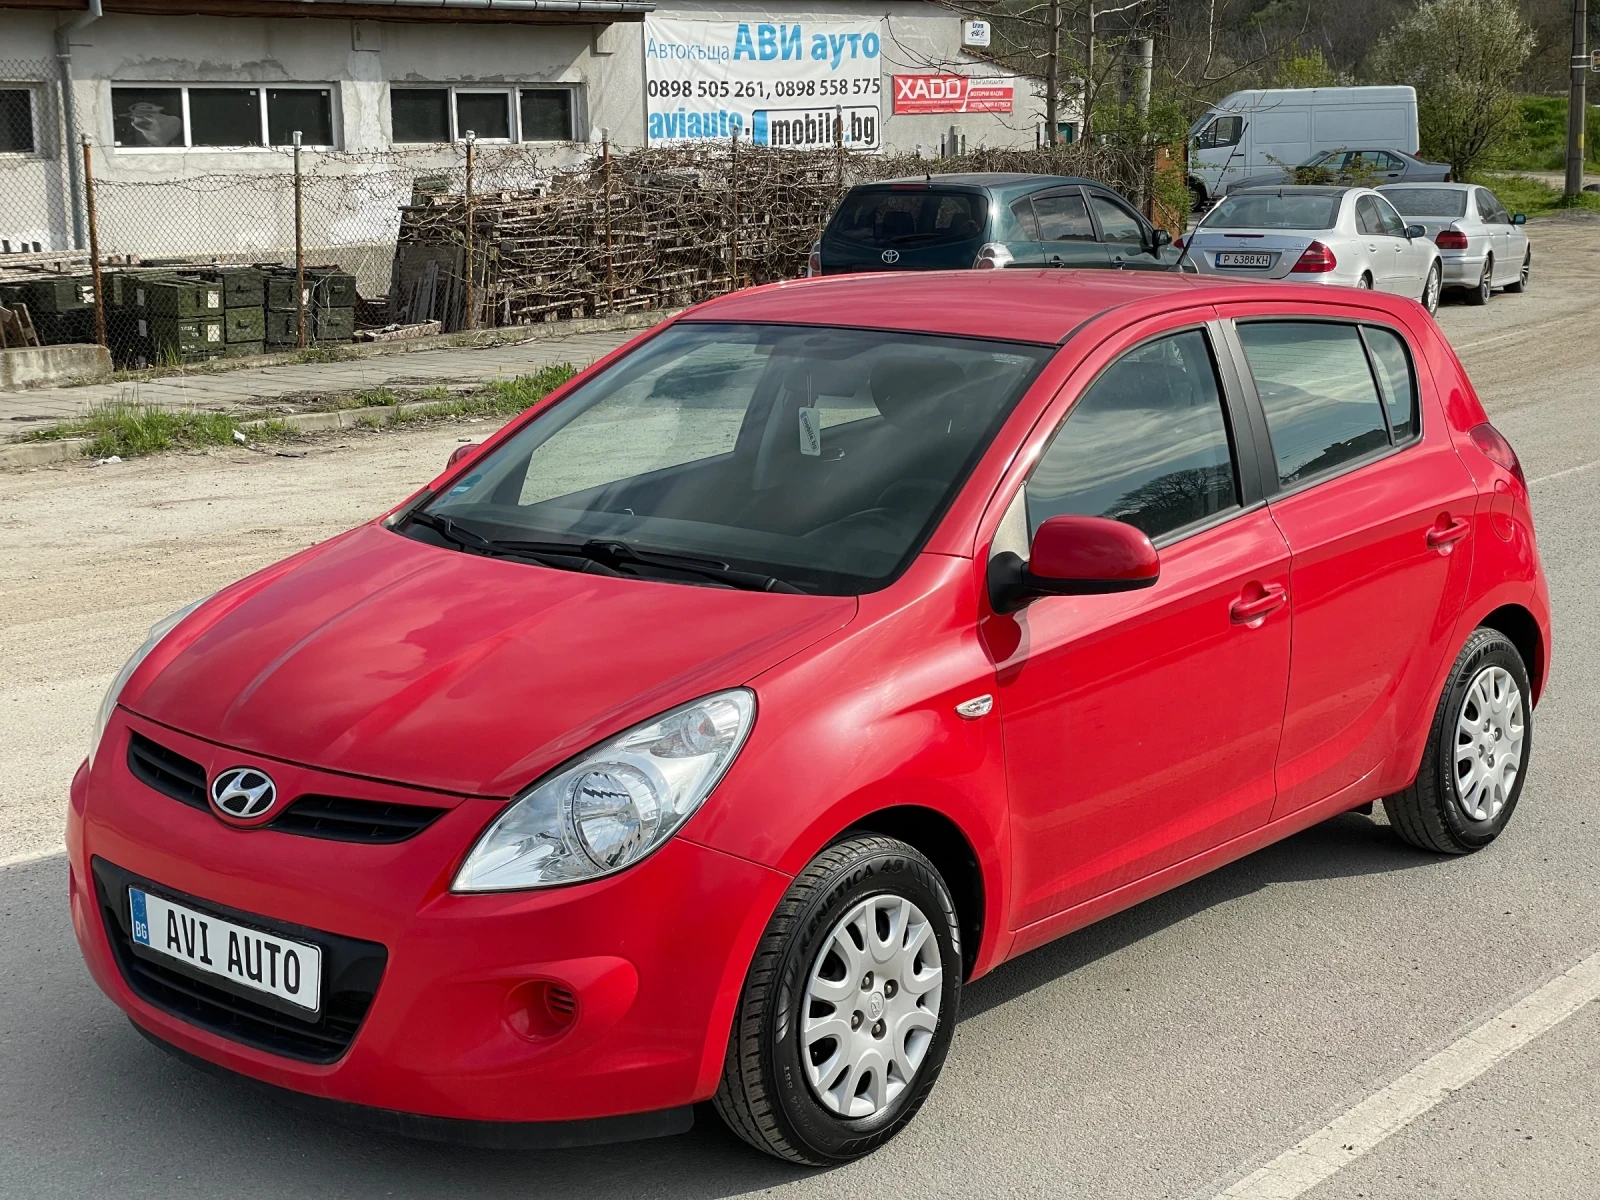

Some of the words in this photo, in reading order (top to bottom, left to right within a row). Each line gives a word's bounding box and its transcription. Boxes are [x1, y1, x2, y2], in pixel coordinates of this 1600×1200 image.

[647, 37, 729, 64] Автокъща
[733, 23, 802, 60] АВИ
[811, 31, 880, 70] ауто
[648, 79, 693, 97] 0898
[697, 80, 730, 97] 505
[734, 81, 770, 99] 261,
[775, 80, 815, 96] 0898
[819, 79, 848, 95] 558
[852, 78, 880, 94] 575
[135, 921, 148, 940] BG
[167, 909, 213, 966] AVI
[227, 930, 301, 994] AUTO
[783, 1064, 793, 1089] 88T
